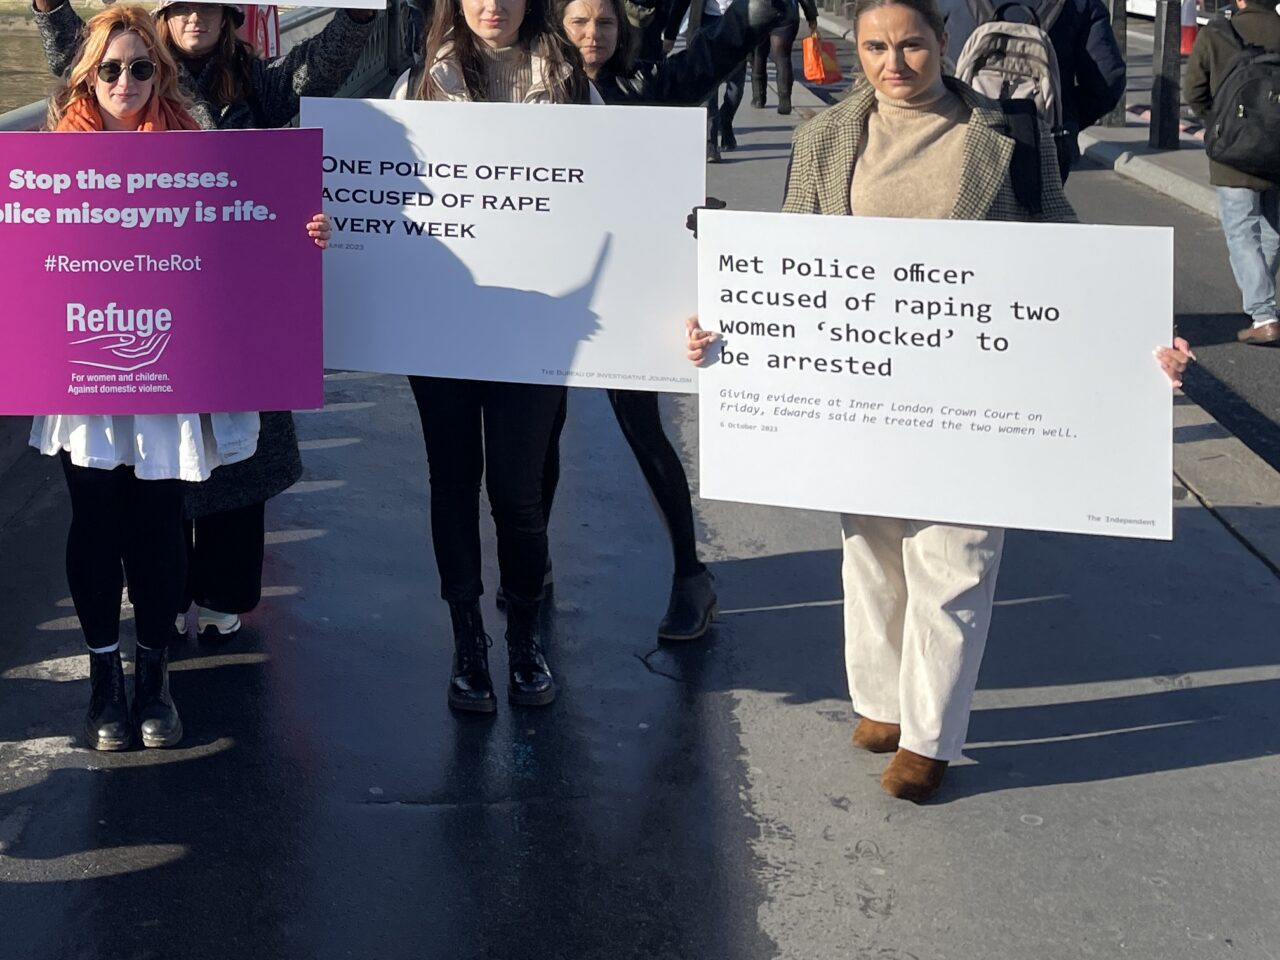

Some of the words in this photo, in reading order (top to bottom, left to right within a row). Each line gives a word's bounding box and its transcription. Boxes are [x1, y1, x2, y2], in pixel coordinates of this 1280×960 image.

[9, 168, 71, 194] Stop
[76, 169, 121, 190] the
[127, 172, 237, 194] presses.
[324, 156, 372, 174] ONE
[380, 161, 468, 179] POLICE
[475, 165, 584, 183] OFFICER
[56, 202, 190, 228] misogyny
[195, 200, 216, 222] is
[222, 200, 276, 221] rife.
[324, 188, 434, 206] ACCUSED
[441, 193, 474, 208] OF
[482, 195, 550, 212] RAPE
[329, 216, 395, 234] VERY
[402, 221, 476, 238] WEEK
[44, 254, 202, 272] #RemoveTheRot
[719, 254, 763, 274] Met
[782, 258, 875, 280] Police
[894, 263, 974, 284] officer
[67, 302, 172, 337] Refuge
[720, 289, 826, 309] accused
[845, 292, 876, 311] of
[895, 297, 992, 322] raping
[1010, 302, 1060, 322] two
[718, 320, 795, 338] women
[976, 332, 1008, 352] to
[721, 346, 749, 366] be
[767, 354, 891, 376] arrested
[68, 384, 98, 395] Against
[100, 384, 137, 393] domestic
[138, 384, 174, 392] violence.
[72, 373, 85, 382] For
[86, 374, 116, 382] women
[118, 372, 134, 382] and
[135, 372, 170, 382] children.
[720, 388, 760, 402] Giving
[767, 393, 821, 405] evidence
[828, 398, 842, 408] at
[848, 399, 884, 410] Inner
[891, 402, 934, 414] London
[940, 406, 976, 417] Crown
[984, 409, 1020, 420] Court
[1028, 413, 1042, 422] on
[720, 402, 765, 416] Friday,
[773, 406, 820, 419] Edwards
[828, 412, 856, 422] said
[862, 413, 876, 424] he
[885, 416, 934, 428] treated
[942, 419, 962, 430] the
[970, 422, 992, 432] two
[998, 425, 1035, 435] women
[1042, 427, 1077, 438] well.
